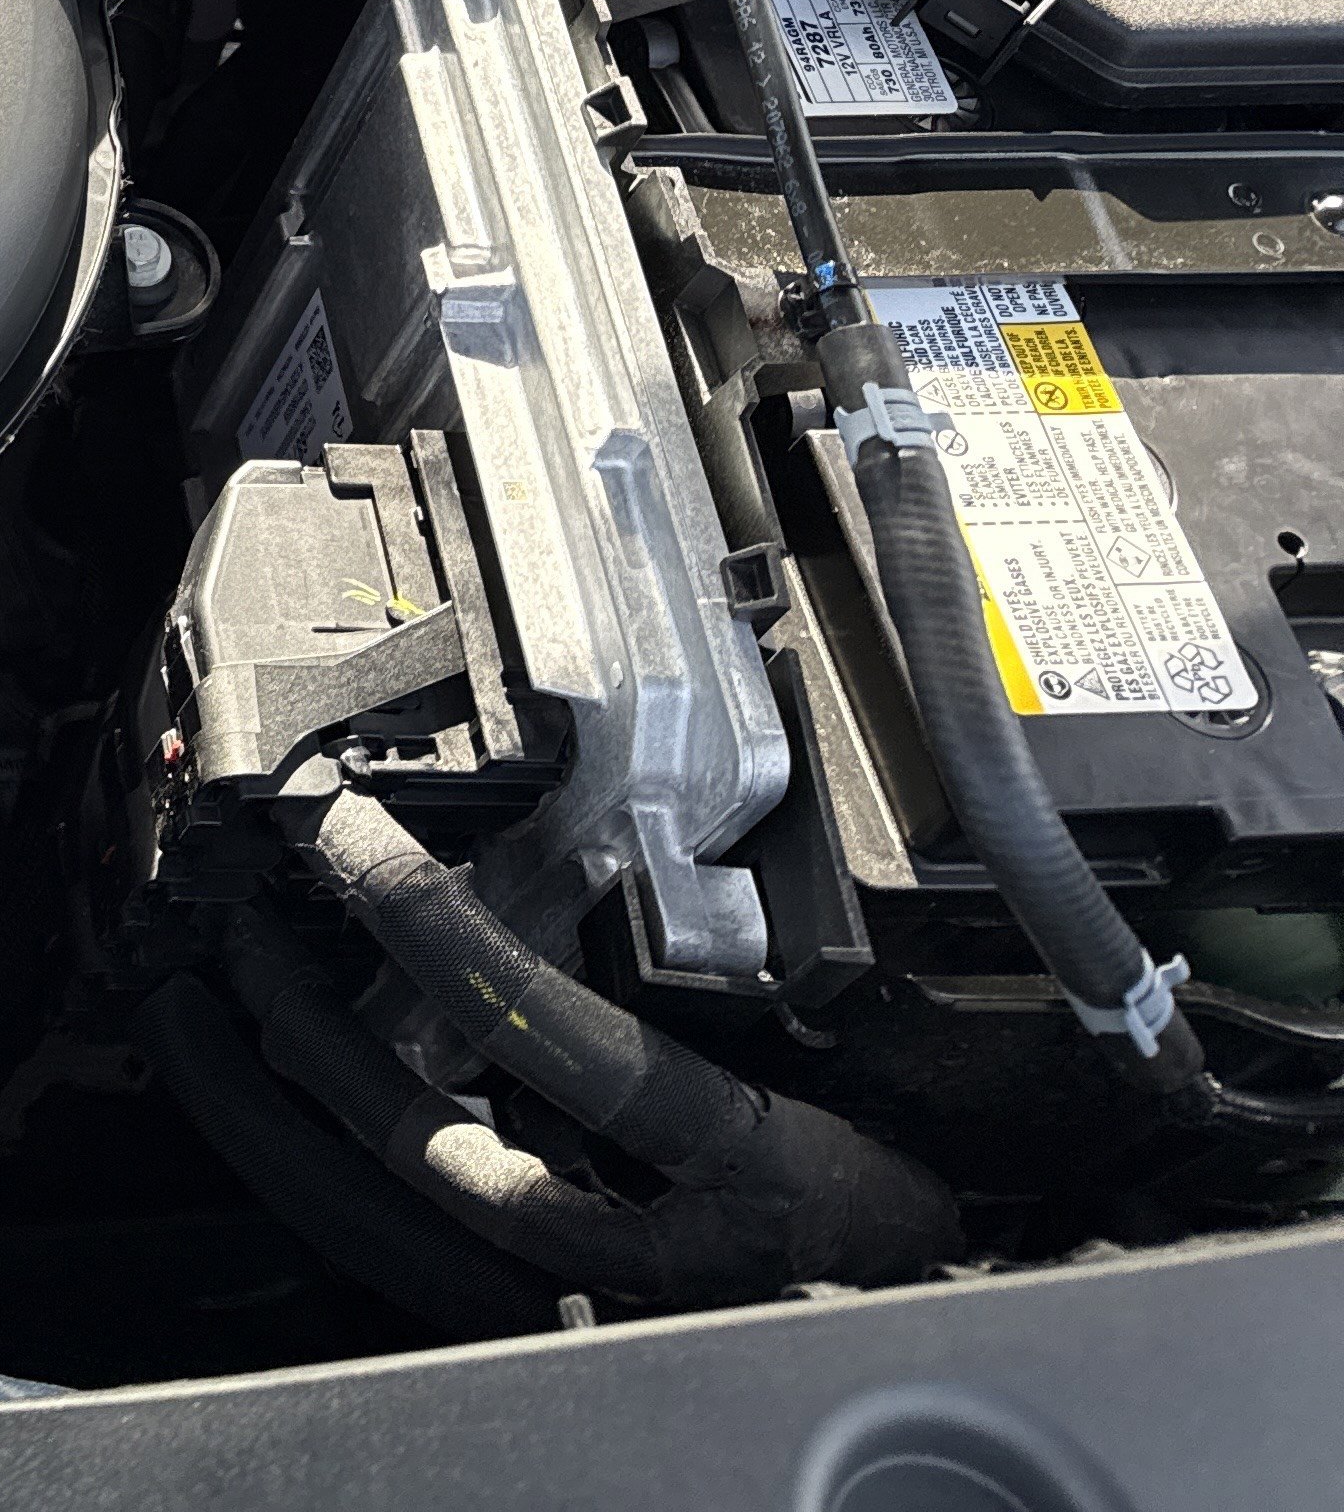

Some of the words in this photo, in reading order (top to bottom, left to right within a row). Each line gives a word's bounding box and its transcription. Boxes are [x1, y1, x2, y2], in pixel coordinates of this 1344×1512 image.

[817, 12, 845, 47] VRLA
[876, 21, 901, 57] MOTORS
[782, 18, 815, 70] 94RAGM
[799, 20, 835, 66] 7287
[861, 27, 883, 57] 80Ah
[890, 24, 925, 81] RENAISSANC
[913, 48, 927, 58] MI
[837, 53, 857, 74] 12V
[863, 75, 877, 88] CCA
[880, 70, 899, 92] 730
[895, 61, 922, 101] GENERAL
[919, 87, 934, 101] 300
[1022, 283, 1042, 299] PAS
[948, 291, 975, 322] CÉCITÉ
[995, 303, 1012, 317] DO
[1032, 303, 1049, 315] NE
[906, 326, 923, 343] CAN
[941, 307, 980, 366] SULFURIQUE
[967, 325, 982, 337] LA
[1007, 332, 1020, 341] OF
[888, 322, 921, 371] SULFURIC
[917, 320, 950, 372] BLINDNESS
[978, 318, 1010, 367] BRÛLURES
[1012, 343, 1027, 357] OUT
[1023, 338, 1043, 360] REACH
[1054, 338, 1068, 348] LA
[914, 349, 934, 369] ACID
[974, 341, 1000, 377] CAUSER
[1059, 351, 1074, 360] DE
[947, 355, 972, 389] SEVERE
[1002, 371, 1019, 387] DES
[942, 378, 965, 406] CAUSE
[969, 370, 996, 405] L'ACIDE
[992, 382, 1012, 404] PEUT
[1012, 392, 1026, 404] OU
[965, 393, 980, 406] OR
[1016, 431, 1046, 476] FLAMMES
[1049, 427, 1082, 479] IMMEDIATELY
[1037, 449, 1061, 481] FUMER
[1091, 456, 1109, 474] HELP
[961, 464, 985, 499] SPARKS
[972, 464, 997, 498] FLAMES
[982, 457, 1010, 498] SMOKING
[958, 493, 975, 507] NO
[1025, 482, 1043, 497] LES
[1039, 482, 1055, 497] LES
[1054, 486, 1068, 498] DE
[1075, 484, 1092, 502] EYES
[1102, 479, 1127, 513] MEDICAL
[1086, 507, 1107, 532] FLUSH
[1103, 512, 1121, 531] WITH
[1121, 518, 1136, 531] GET
[1135, 513, 1151, 529] YEUX
[1144, 533, 1159, 546] LES
[1059, 532, 1091, 578] PEUVENT
[1160, 533, 1189, 574] CONSULTEZ
[1003, 558, 1031, 594] GASES
[1050, 586, 1064, 599] OR
[1082, 583, 1121, 645] EXPLOSIFS
[1098, 586, 1127, 626] RENDRE
[1042, 605, 1066, 637] CAUSE
[1079, 614, 1098, 633] LES
[1133, 604, 1156, 640] BATTERY
[1154, 598, 1180, 639] RECYCLED
[1023, 601, 1062, 663] EXPLOSIVE
[1057, 604, 1093, 662] BLINDNESS
[1120, 633, 1136, 645] OU
[1184, 629, 1198, 640] LA
[1018, 625, 1047, 664] SHIELD
[1059, 643, 1078, 663] CAN
[1089, 639, 1129, 699] PROTÉGEZ
[1113, 652, 1133, 671] GAZ
[1188, 665, 1205, 680] Pb
[1128, 651, 1160, 699] BLESSER
[1125, 679, 1145, 699] LES
